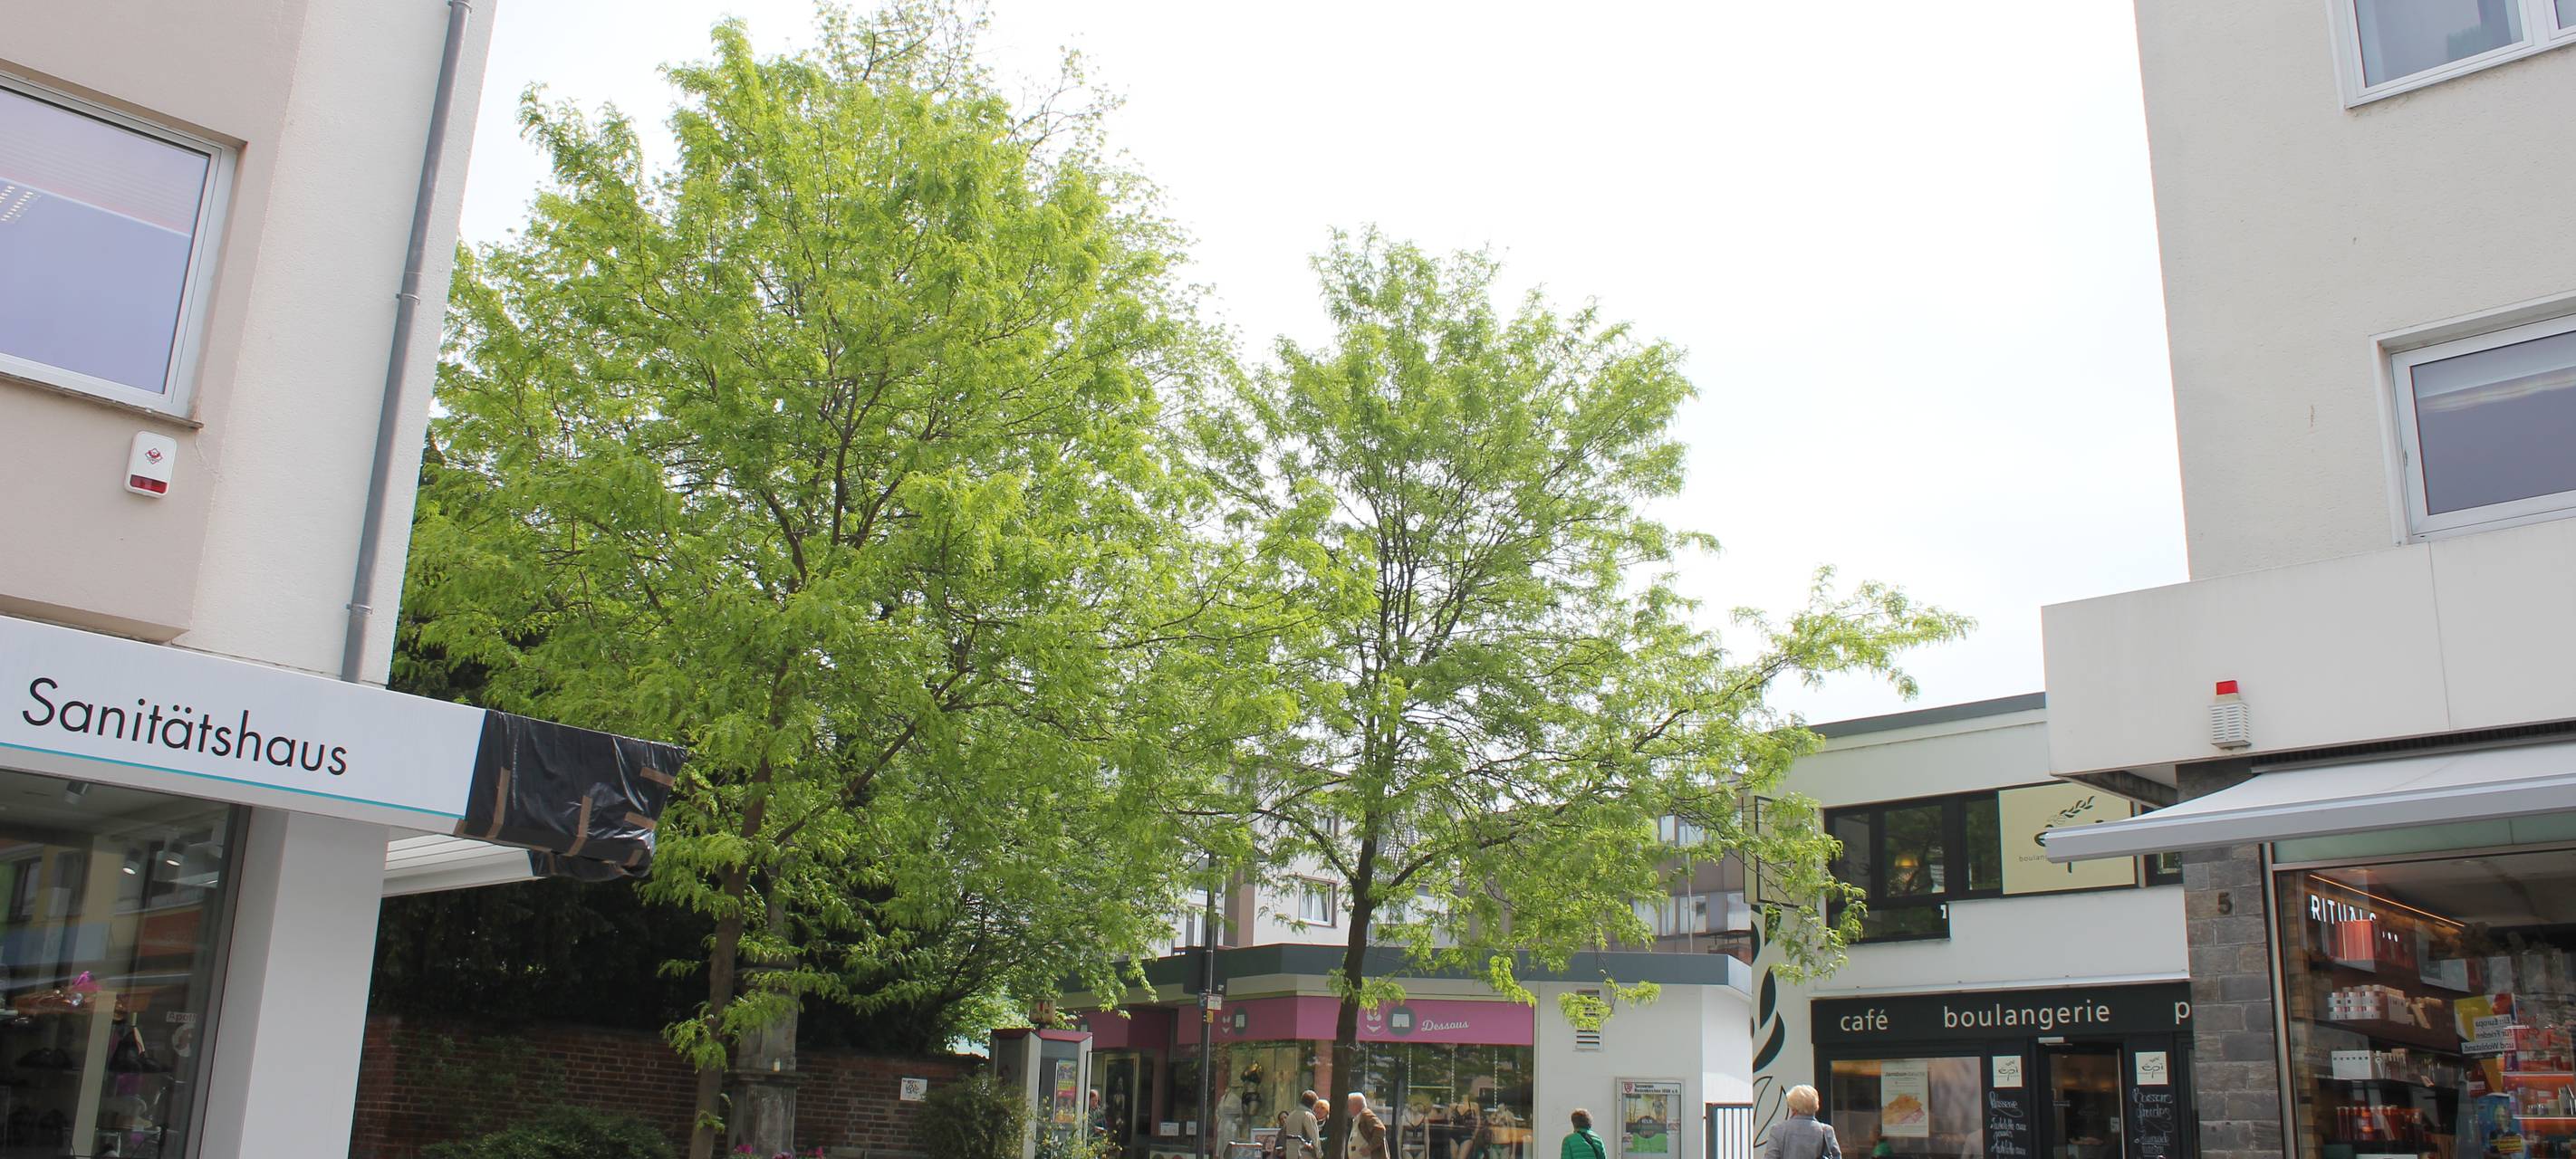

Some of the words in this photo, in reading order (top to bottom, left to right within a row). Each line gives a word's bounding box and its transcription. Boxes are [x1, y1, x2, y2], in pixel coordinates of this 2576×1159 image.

[23, 677, 348, 776] Sanitätshaus
[2217, 891, 2233, 915] 5
[1421, 1020, 1469, 1031] Dessous
[1841, 1008, 1889, 1032] café
[1944, 999, 2110, 1030] boulangerie
